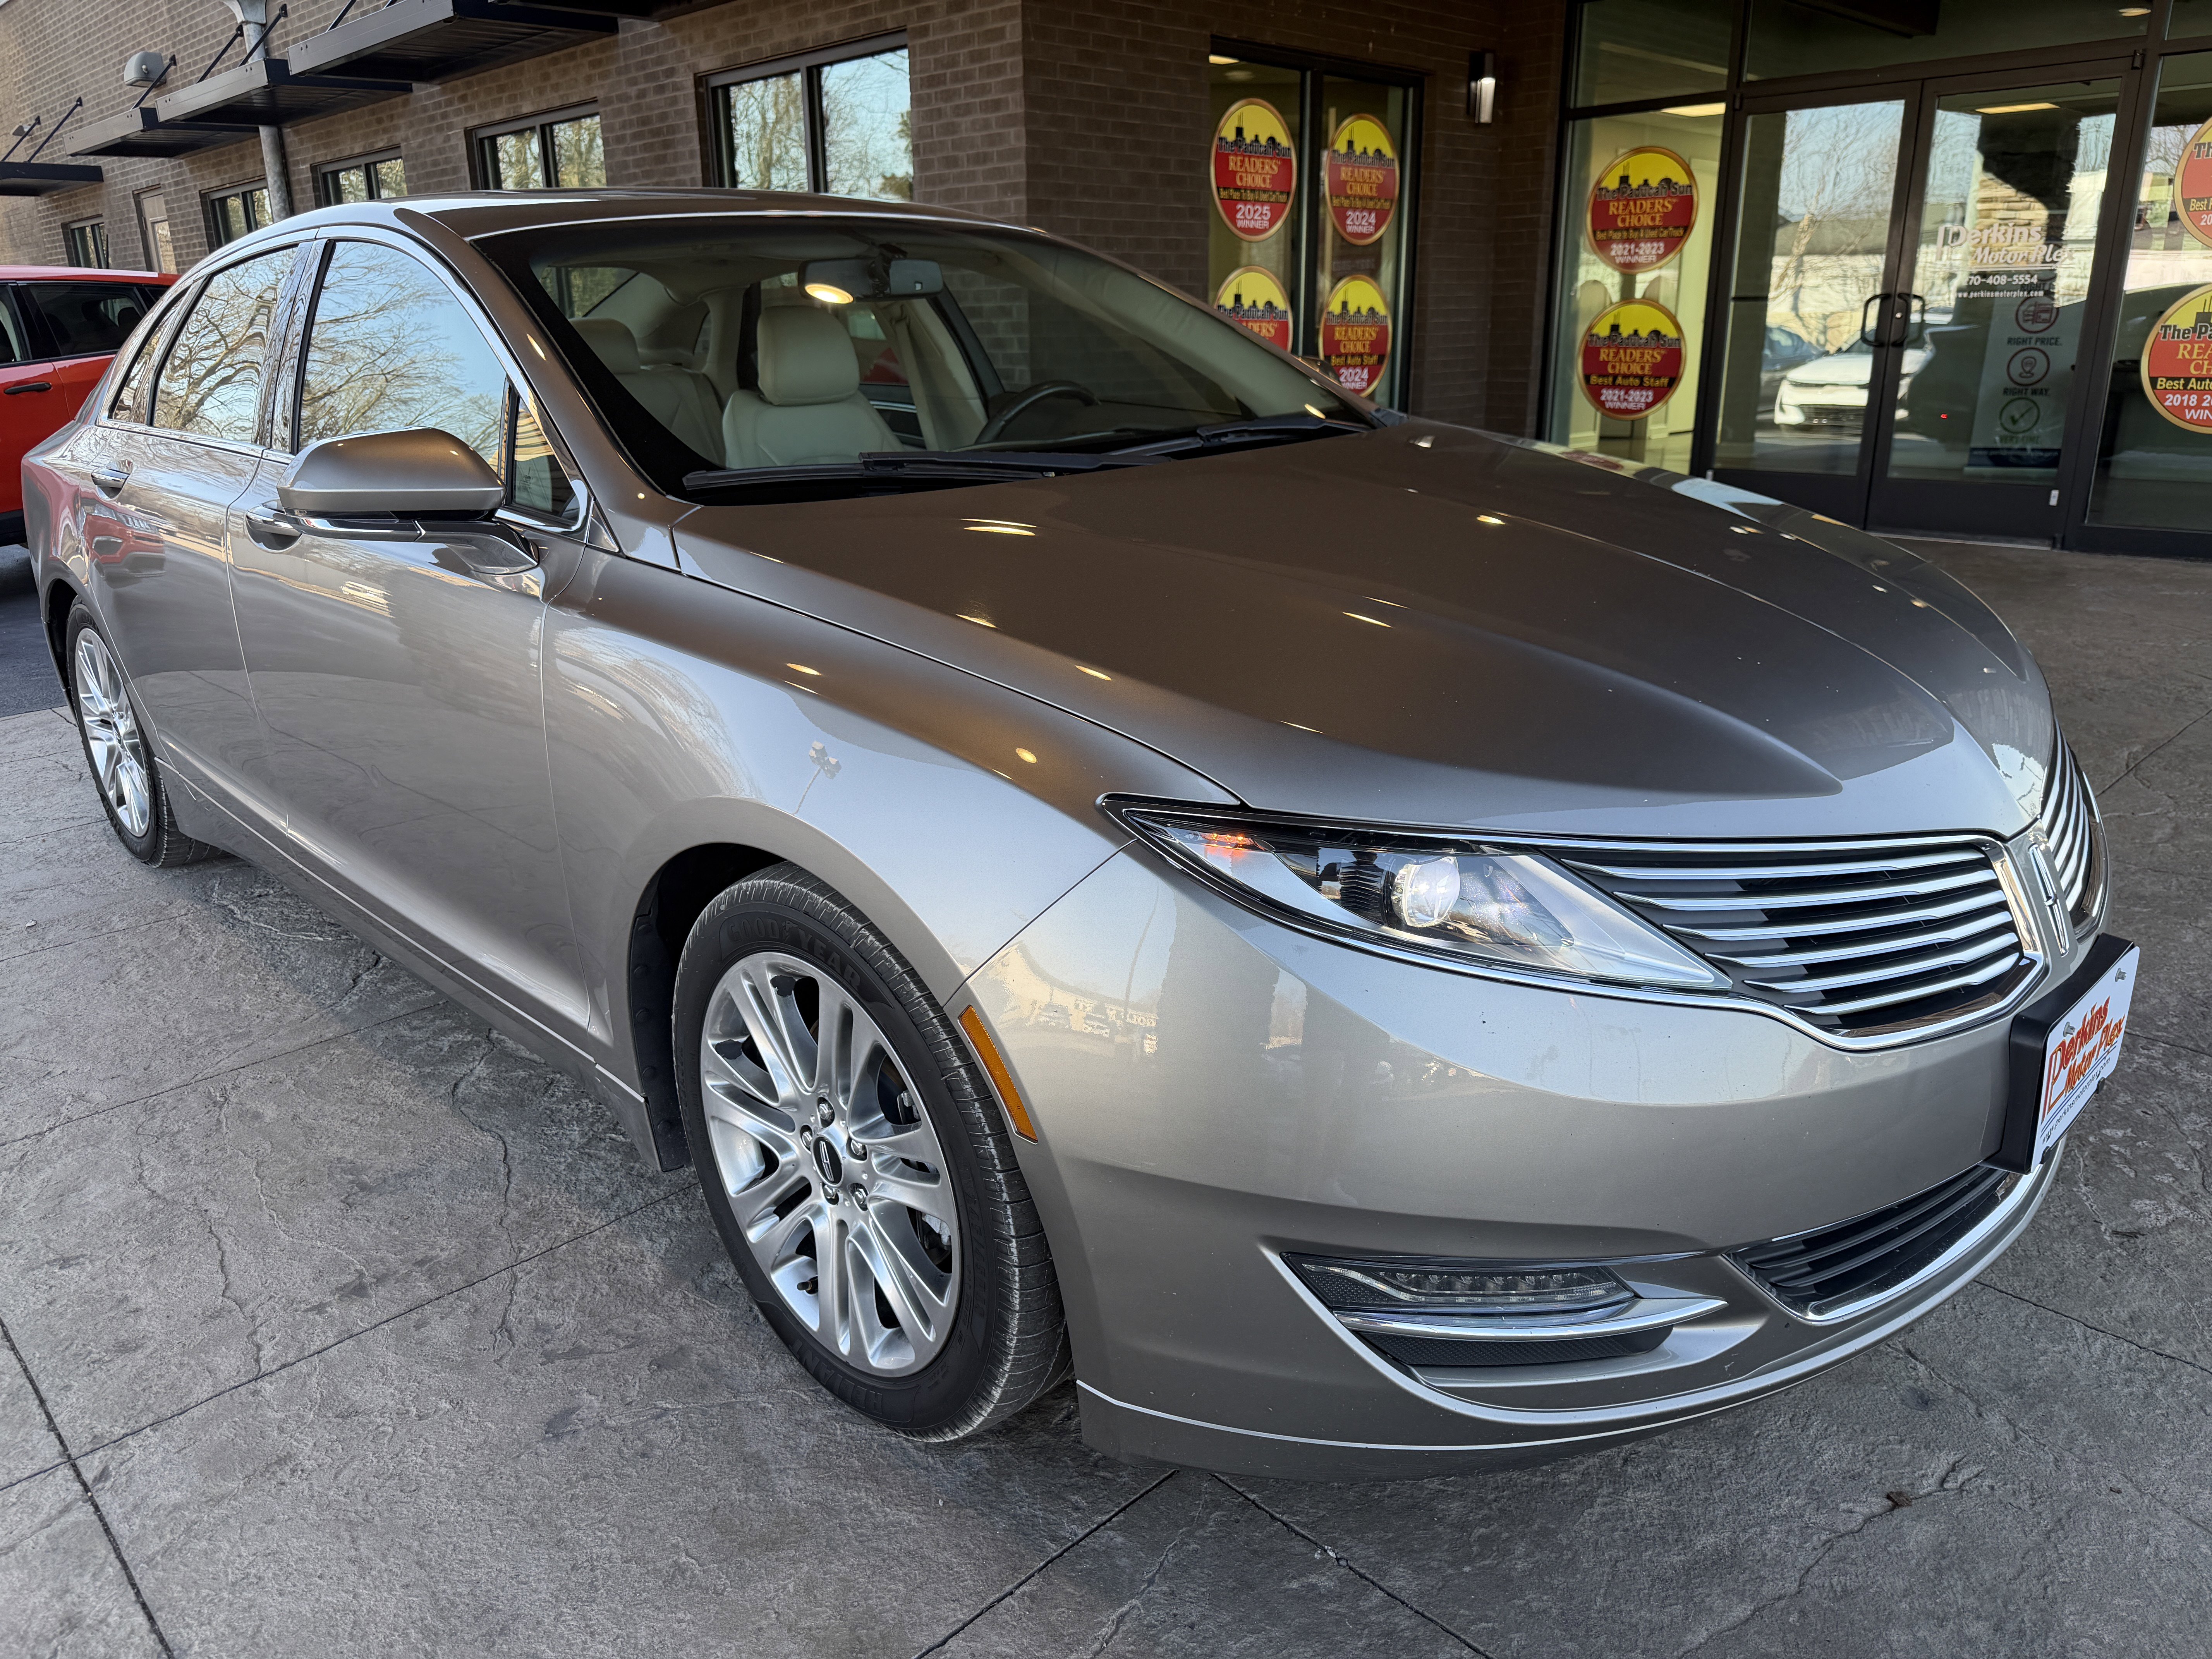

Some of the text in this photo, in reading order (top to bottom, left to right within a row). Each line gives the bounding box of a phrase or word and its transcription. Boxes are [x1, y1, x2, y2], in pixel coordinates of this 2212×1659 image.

[1218, 137, 1235, 153] The
[1275, 142, 1291, 159] Sun
[1236, 172, 1273, 188] CHOICE
[1346, 182, 1378, 196] CHOICE
[1236, 203, 1271, 220] 2025
[2189, 198, 2208, 211] Best
[1236, 219, 1269, 229] WINNER
[1346, 210, 1376, 225] 2024
[1617, 213, 1664, 227] CHOICE
[1346, 224, 1375, 234] WINNER
[1610, 241, 1665, 256] 2021-2023
[1936, 222, 2042, 262] Perkins
[1614, 254, 1657, 264] WINNER
[1973, 244, 2075, 264] Motor Plex
[2159, 323, 2192, 341] The
[1340, 340, 1371, 353] CHOICE
[2007, 337, 2032, 346] RIGHT
[1331, 354, 1379, 366] Best Auto Staff
[1339, 366, 1369, 382] 2024
[1607, 362, 1653, 375] CHOICE
[1589, 374, 1670, 388] Best Auto Staff
[2157, 377, 2185, 390] Best
[1600, 388, 1654, 403] 2021-2023
[2003, 388, 2028, 397] RIGHT
[1604, 401, 1646, 410] WINNER
[2164, 394, 2197, 407] 2018
[2064, 1013, 2126, 1098] Motor Plex
